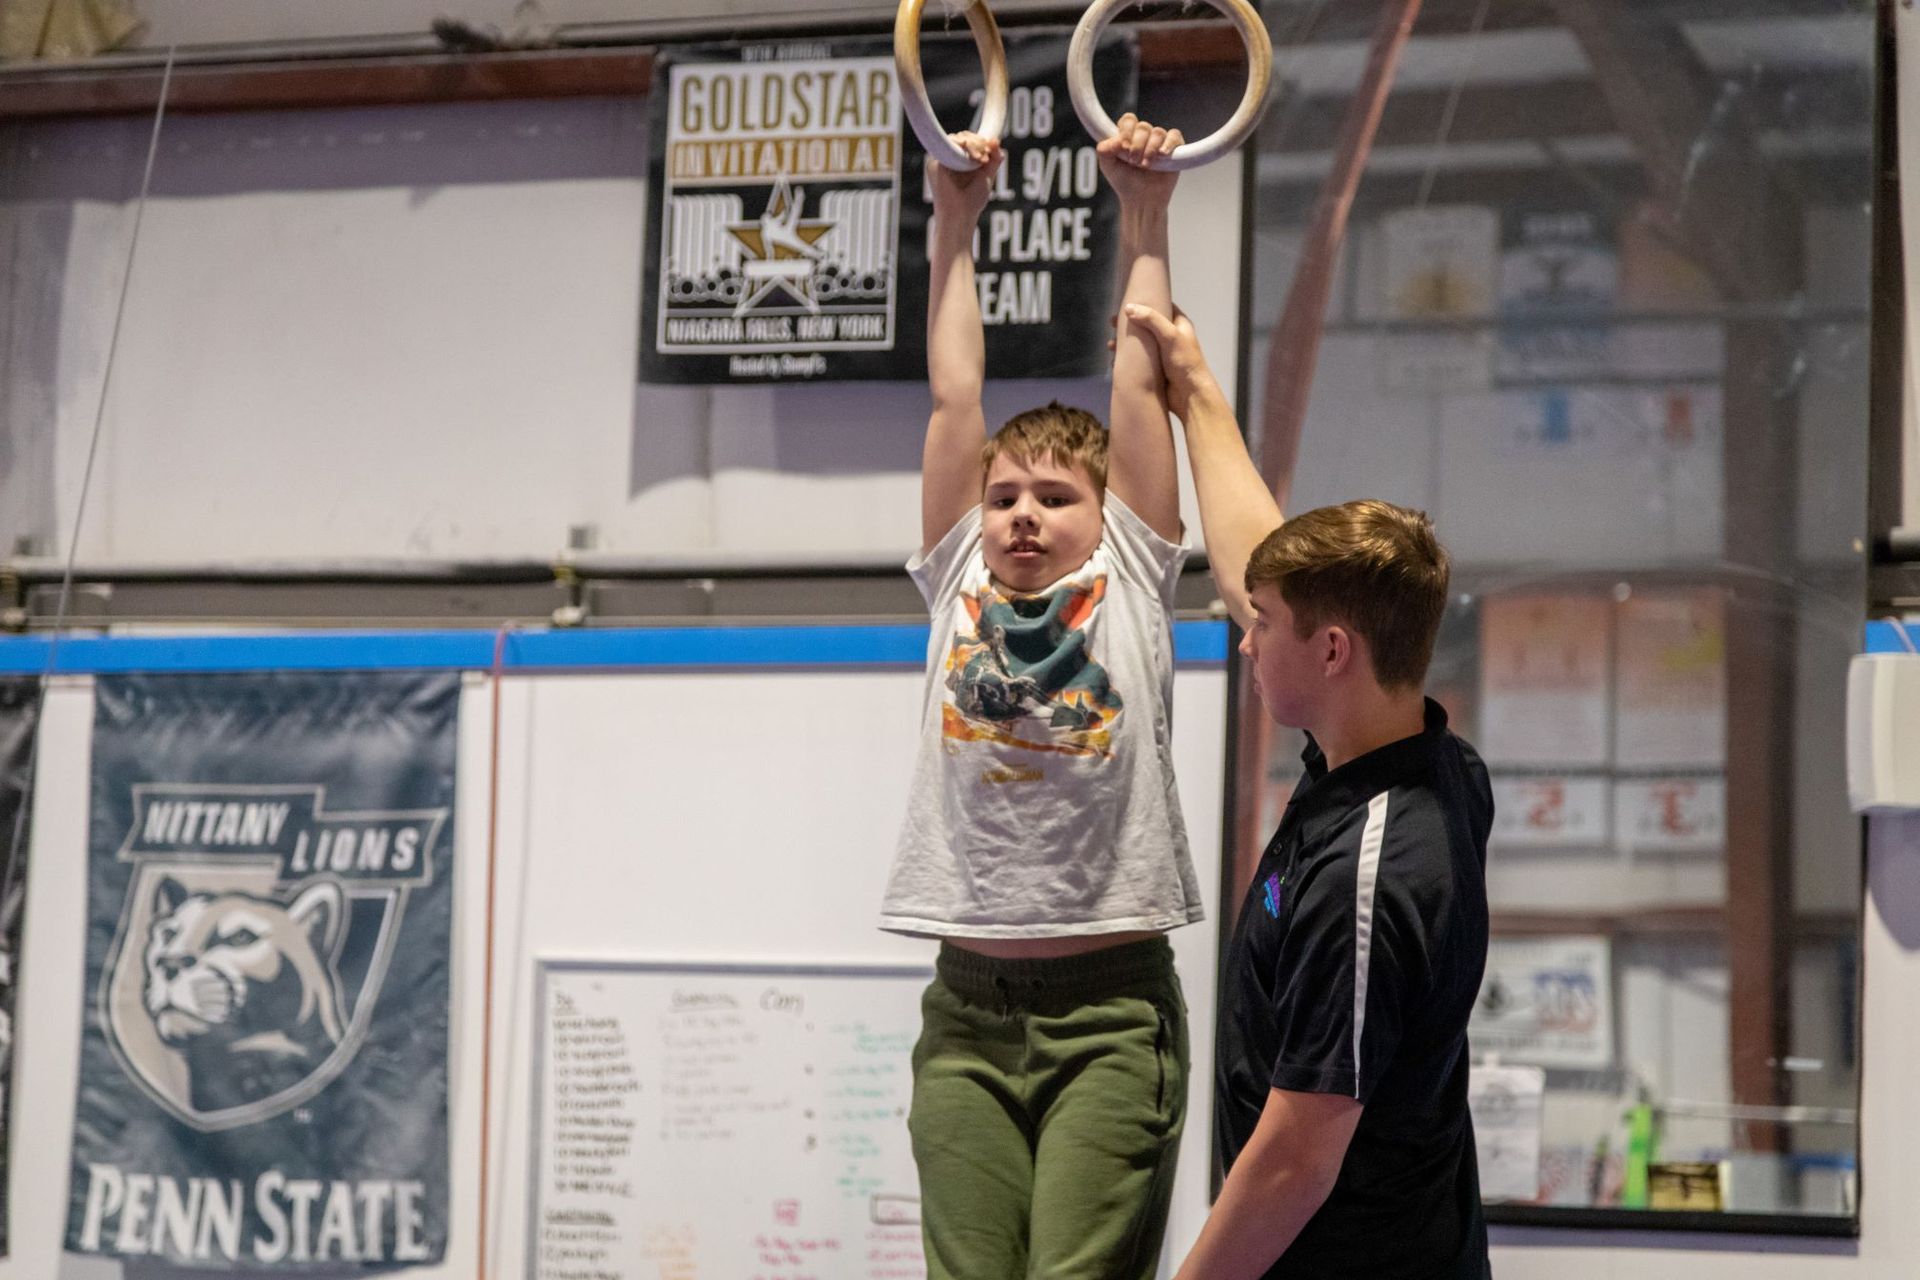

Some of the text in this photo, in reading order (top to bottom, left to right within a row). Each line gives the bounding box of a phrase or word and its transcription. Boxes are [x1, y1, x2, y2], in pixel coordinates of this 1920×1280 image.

[681, 69, 890, 133] GOLDSTAR
[968, 86, 1054, 139] 208
[674, 137, 892, 177] INVITATIONAL
[1022, 146, 1098, 205] 9/10
[989, 207, 1093, 263] PLACE
[667, 317, 745, 343] NIAGARA
[796, 314, 837, 341] NEW
[838, 313, 886, 340] YORK
[143, 801, 290, 846] NITTANY
[290, 826, 420, 873] LIONS
[78, 1162, 245, 1263] PENN
[253, 1168, 431, 1264] STATE
